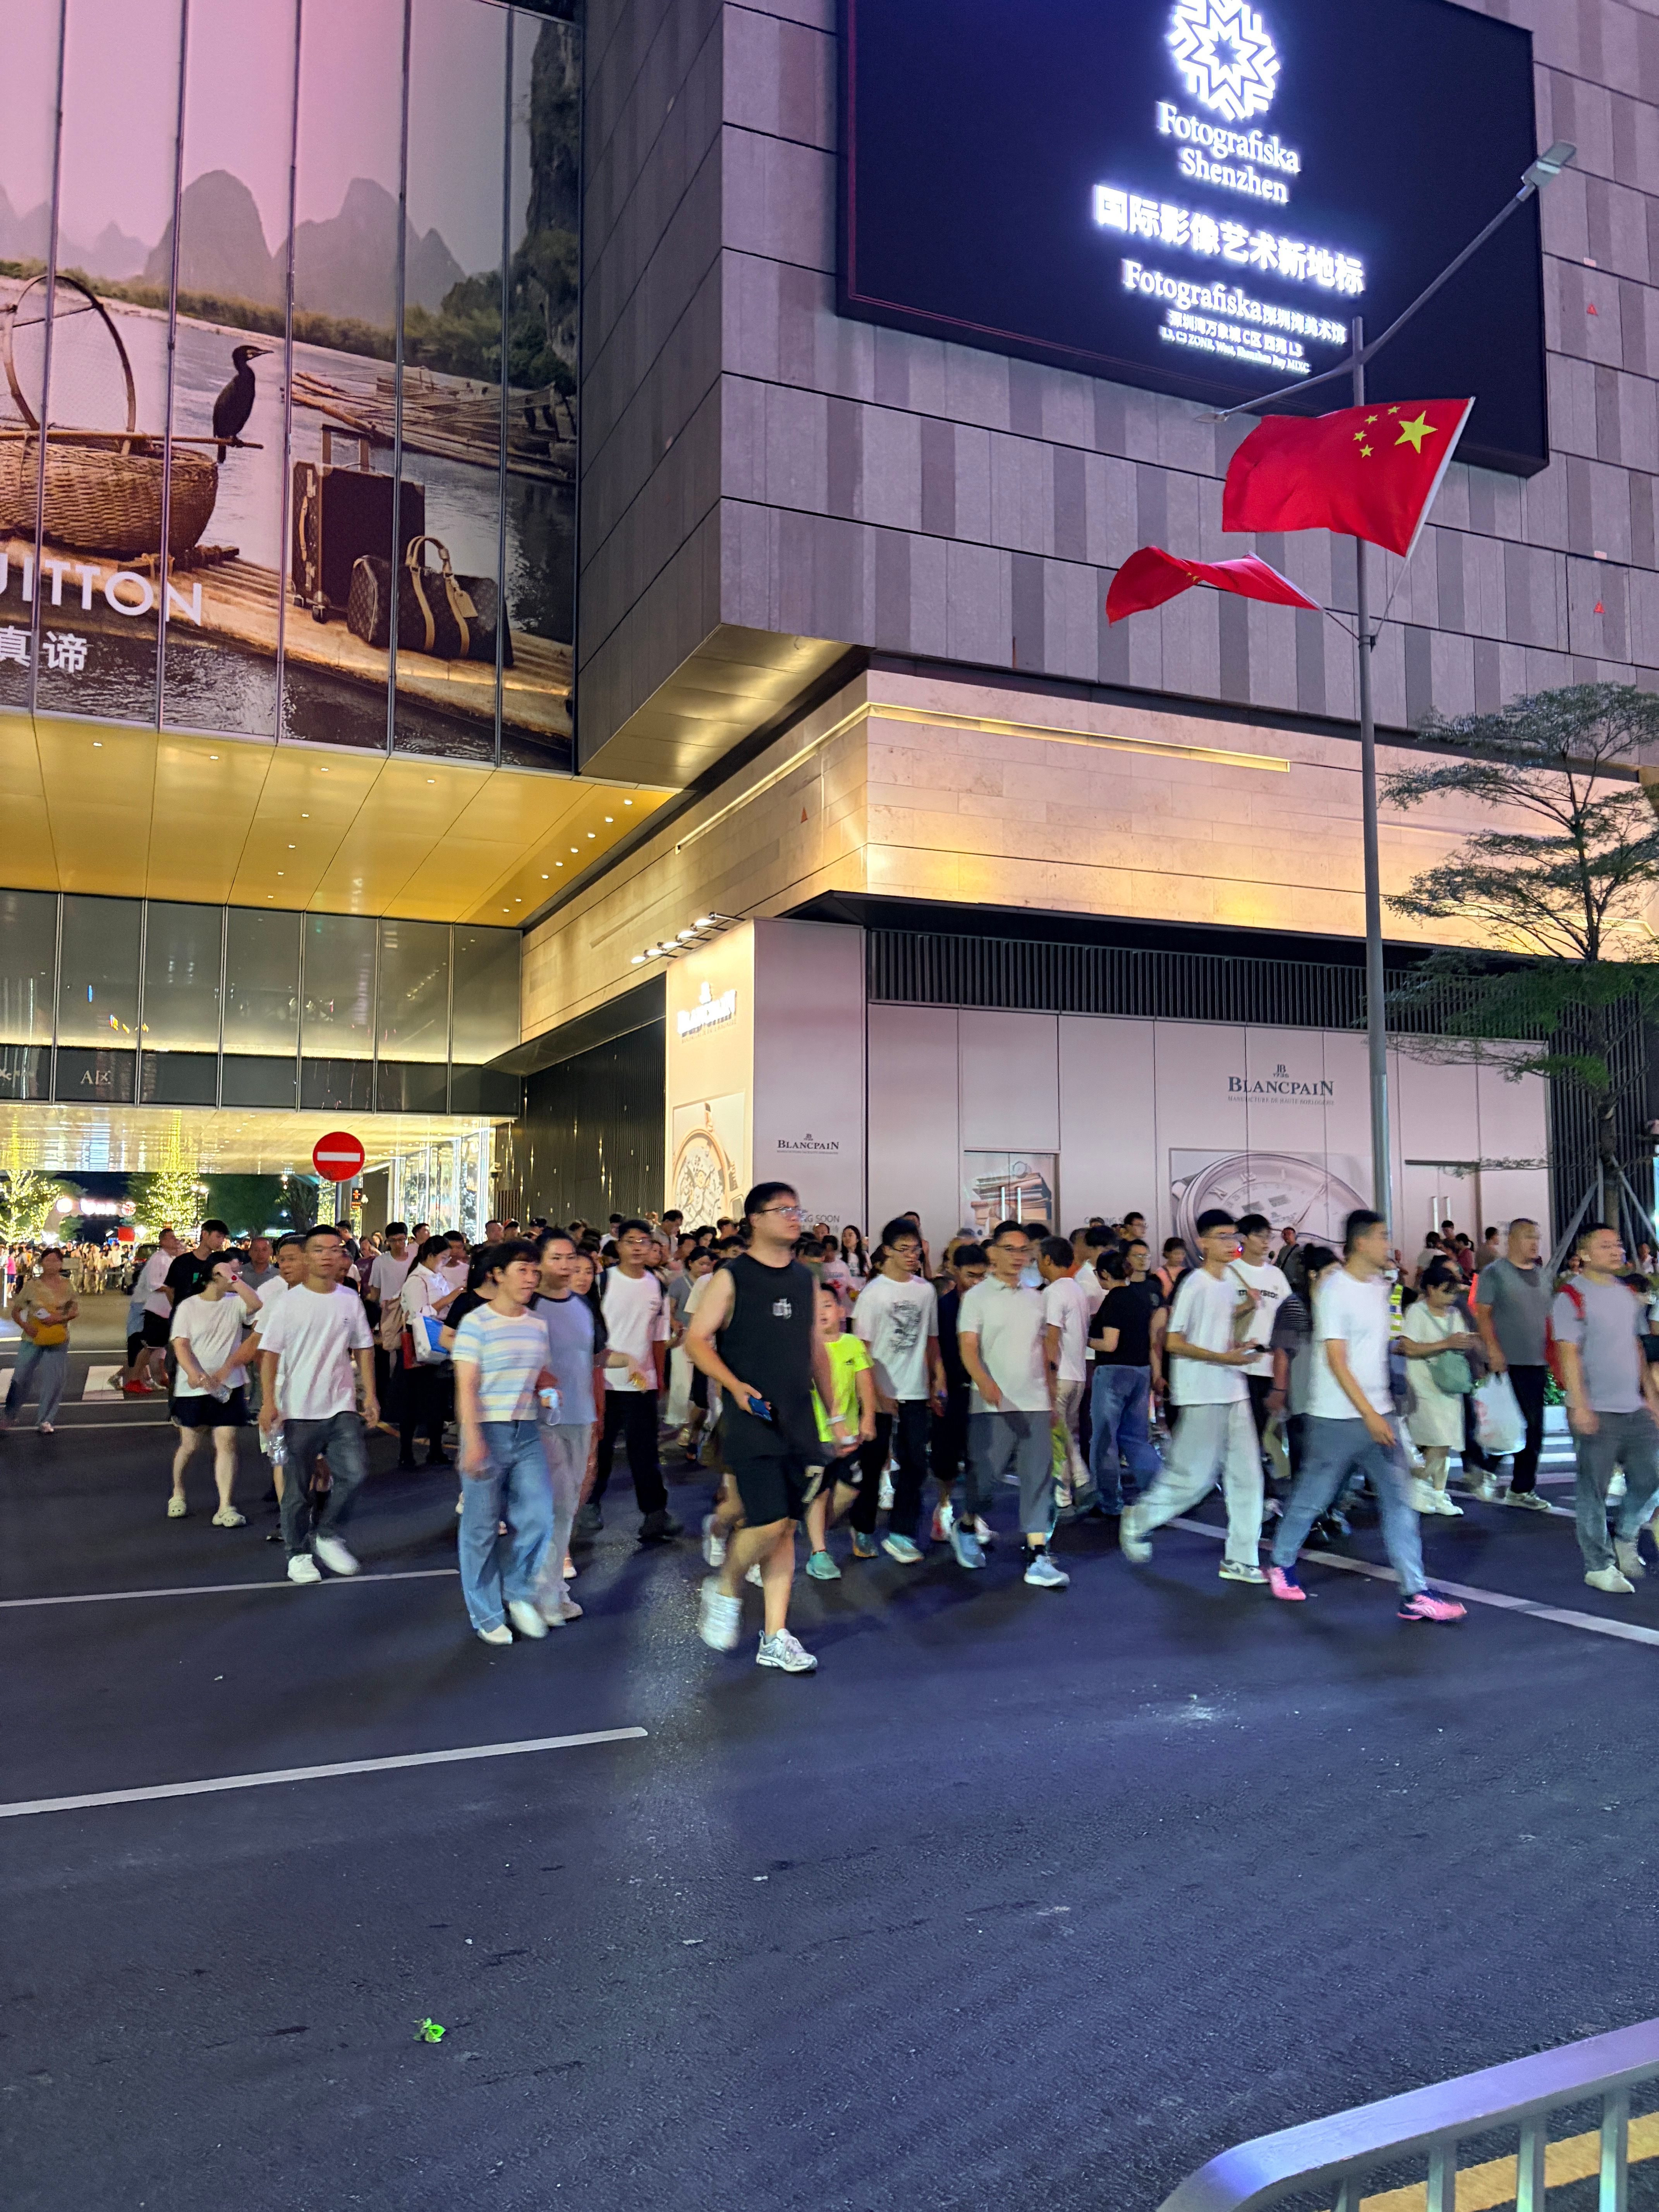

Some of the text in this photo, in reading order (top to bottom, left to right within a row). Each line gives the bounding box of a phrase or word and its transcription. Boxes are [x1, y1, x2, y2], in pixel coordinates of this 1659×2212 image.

[1158, 101, 1301, 173] Fotografiska
[1182, 148, 1289, 203] Shenzhen
[1094, 185, 1365, 294] 国际影像艺术新地标
[1288, 341, 1303, 357] L3
[1286, 358, 1310, 373] MIXC
[0, 625, 87, 673] 真谛
[1228, 1076, 1334, 1096] BLANCPAIN
[777, 1140, 839, 1150] BLANCPAIN
[816, 1214, 840, 1223] SOON
